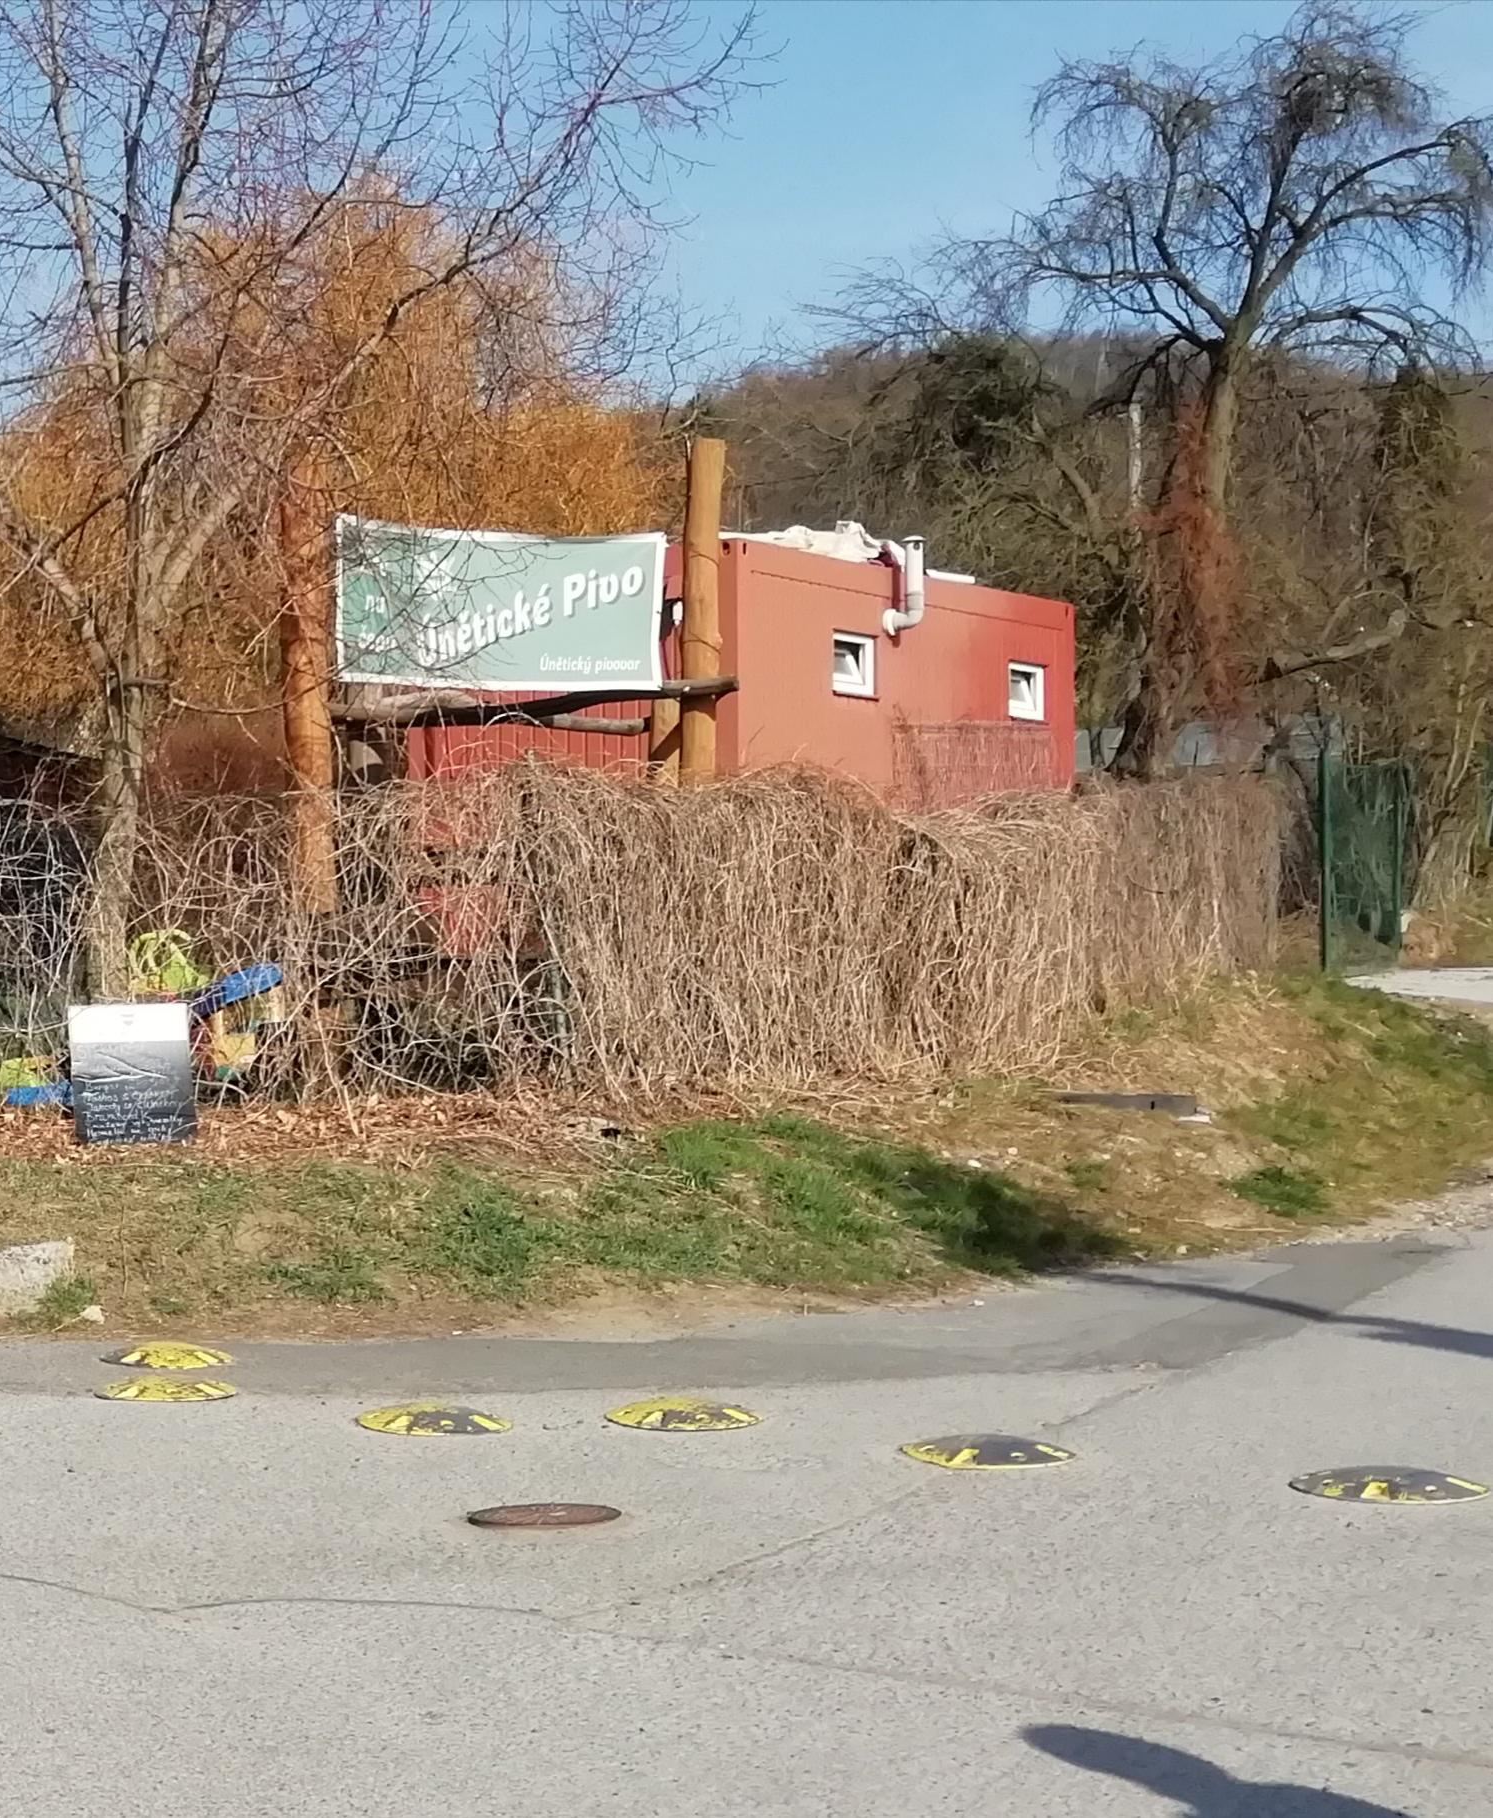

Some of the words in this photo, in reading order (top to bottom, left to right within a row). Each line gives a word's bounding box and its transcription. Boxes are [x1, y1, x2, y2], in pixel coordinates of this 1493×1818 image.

[416, 583, 552, 667] Únětické
[563, 566, 645, 617] Pivo
[540, 653, 591, 674] Únětický
[595, 656, 640, 674] pivovar
